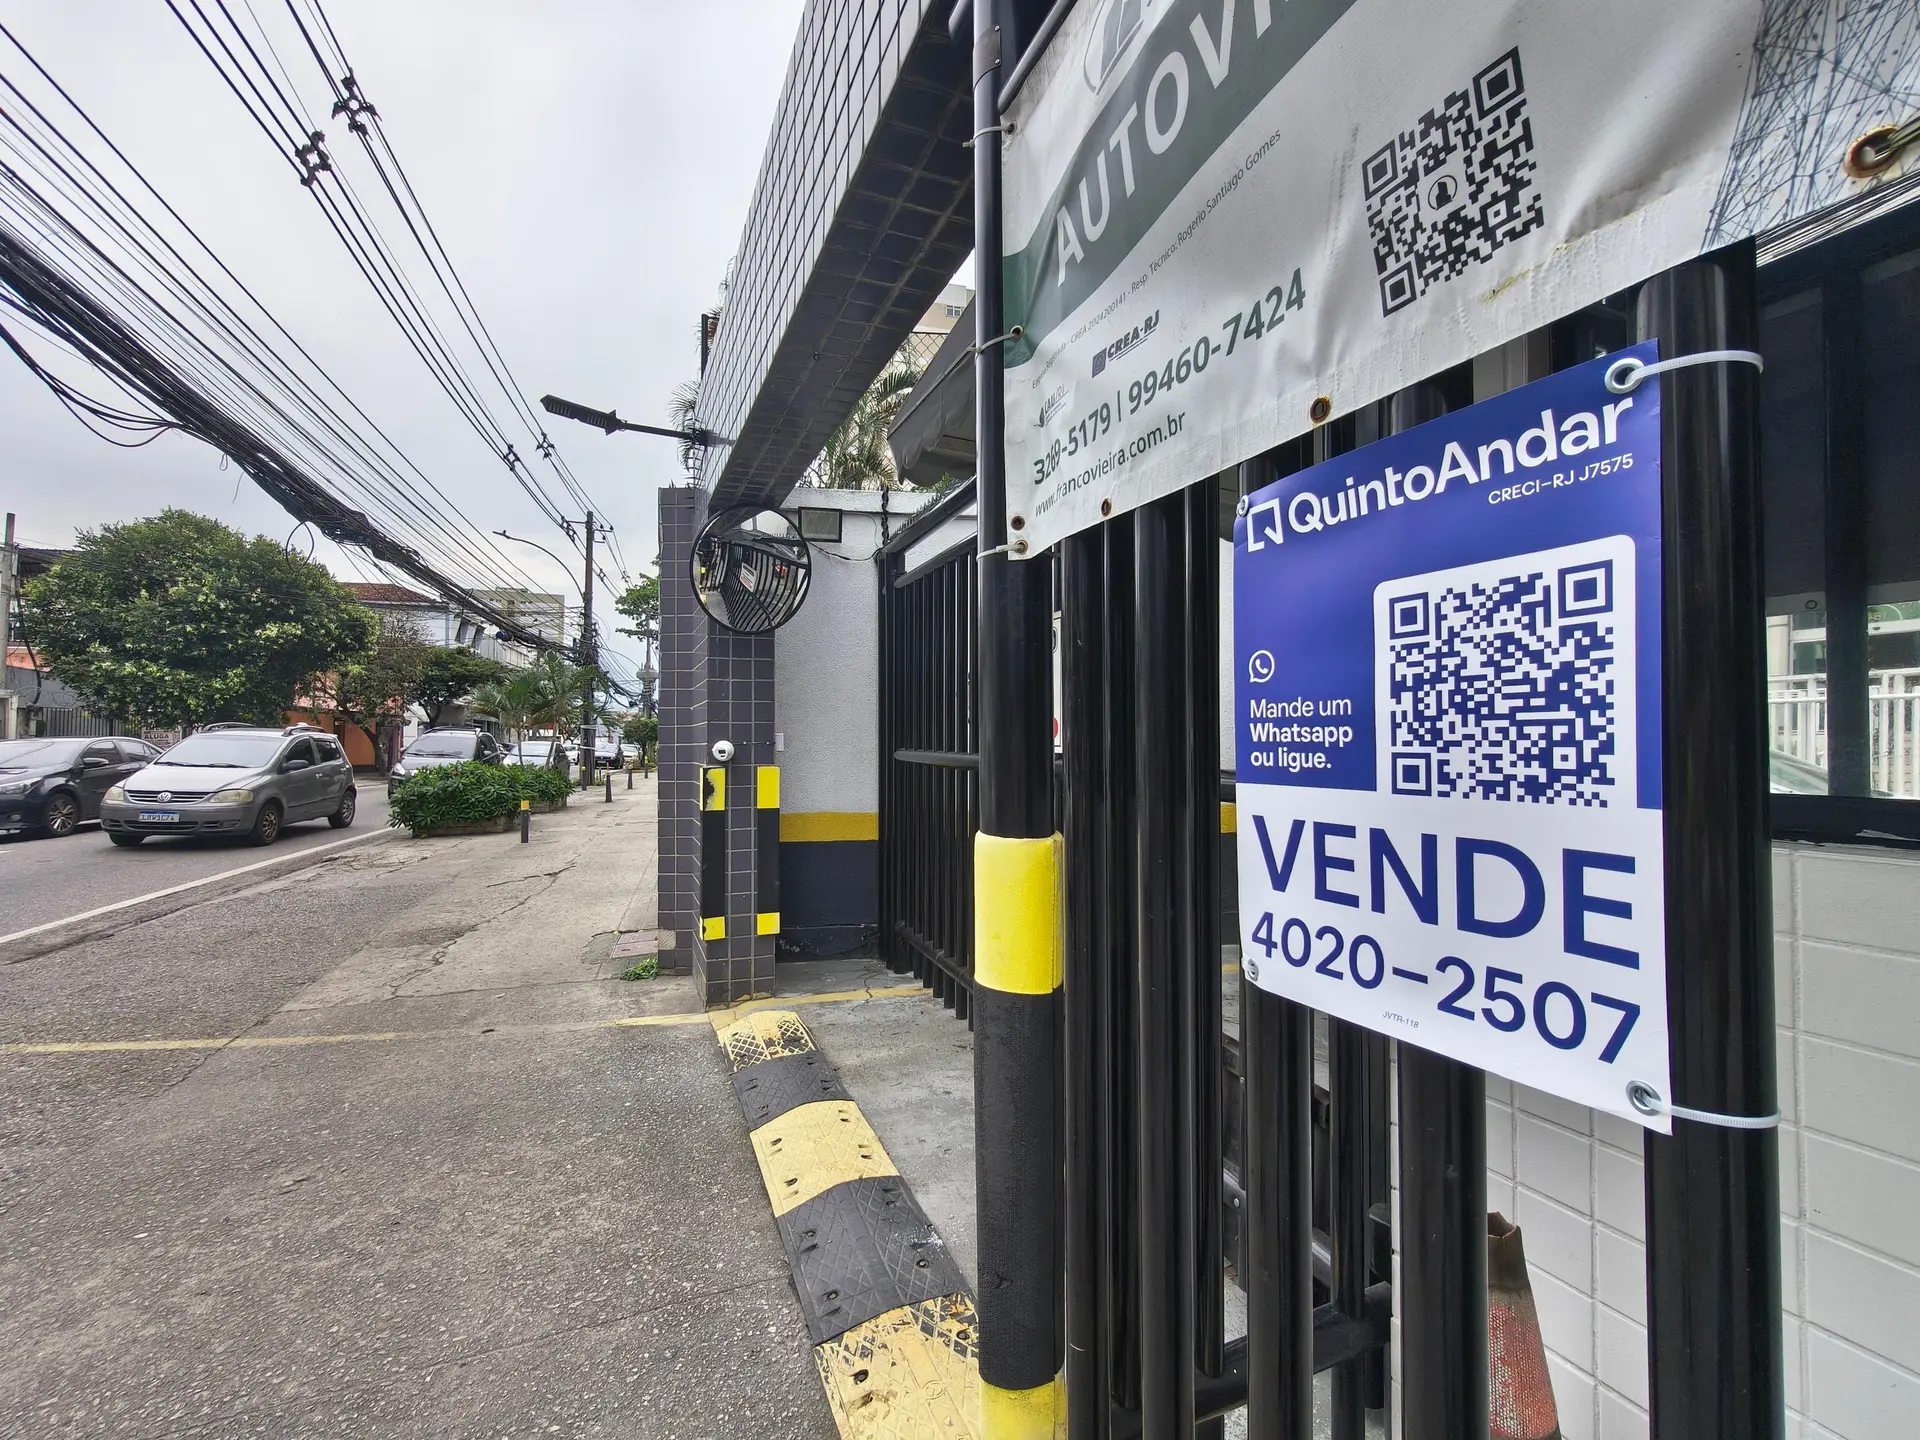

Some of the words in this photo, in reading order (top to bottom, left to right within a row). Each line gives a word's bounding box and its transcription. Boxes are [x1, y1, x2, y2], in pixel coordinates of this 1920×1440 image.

[1206, 169, 1244, 214] Santiago
[1245, 129, 1281, 171] Gomes
[1107, 309, 1160, 359] CREA-RJ
[1033, 402, 1111, 485] 3269-5179
[1128, 267, 1306, 415] 99460-7424
[1035, 411, 1186, 517] www.francovieira.com.br
[1288, 396, 1634, 534] QuintoAndar
[1487, 470, 1575, 505] CRECI-RJ
[1579, 453, 1634, 482] J7575
[1250, 697, 1314, 718] Mande
[1319, 698, 1351, 716] um
[1250, 722, 1353, 747] Whatsapp
[1250, 751, 1276, 768] ou
[1278, 747, 1332, 772] ligue.
[1252, 815, 1640, 970] VENDE
[1251, 911, 1641, 1064] 4020-2507
[1382, 1010, 1420, 1028] JVTR-118
